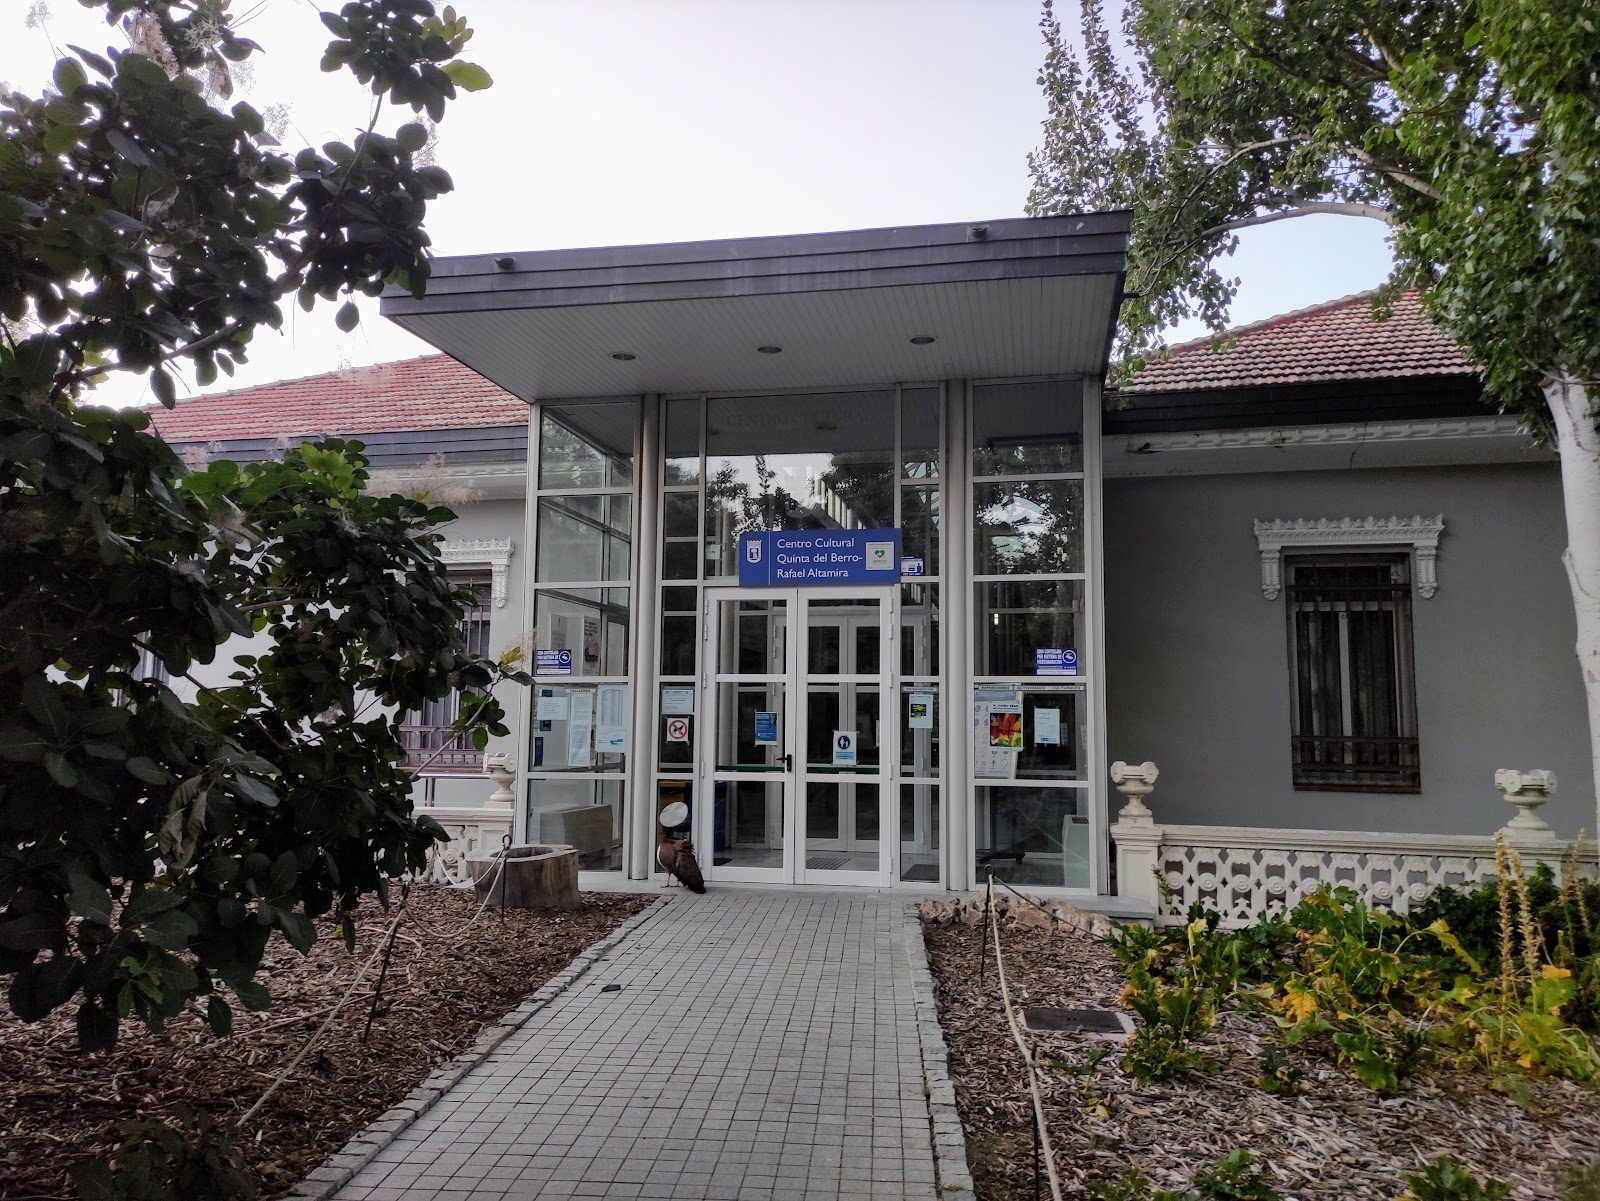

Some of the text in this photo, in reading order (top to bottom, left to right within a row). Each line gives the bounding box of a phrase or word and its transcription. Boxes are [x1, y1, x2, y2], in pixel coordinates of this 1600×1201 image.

[777, 538, 855, 549] Centro Cultural
[777, 552, 863, 564] Quinta del Berro-
[777, 567, 849, 578] Rafael Altamira
